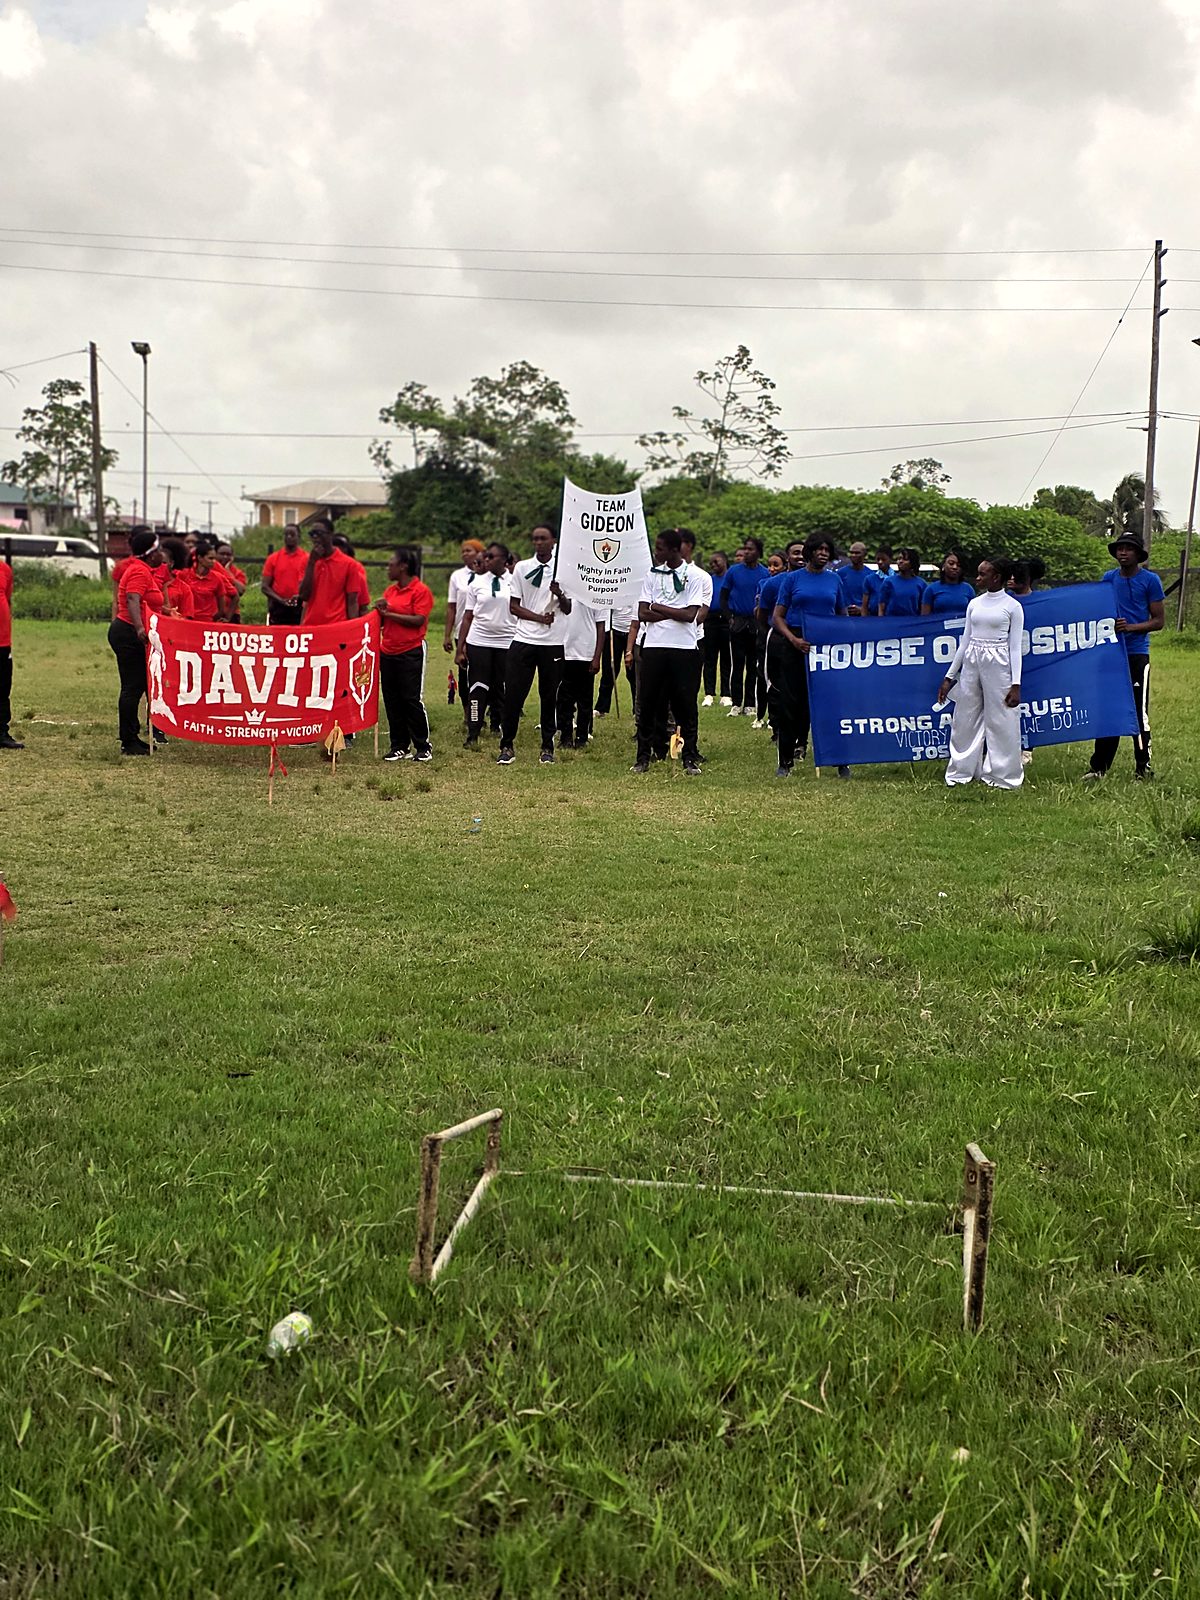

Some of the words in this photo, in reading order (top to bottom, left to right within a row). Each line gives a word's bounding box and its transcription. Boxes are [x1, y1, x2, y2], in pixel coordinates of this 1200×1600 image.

[596, 499, 626, 512] TEAM
[581, 512, 635, 533] GIDEON
[577, 563, 603, 576] Mighty
[613, 567, 631, 575] Faith
[580, 574, 618, 584] Victorious
[588, 585, 619, 594] Purpose
[203, 631, 274, 654] HOUSE
[285, 633, 314, 653] OF
[809, 636, 925, 672] HOUSE
[933, 635, 964, 664] O
[1022, 617, 1119, 656] SHUA
[175, 650, 338, 711] DAVID
[840, 715, 933, 735] STRONG
[1019, 696, 1072, 718] RUE!
[183, 720, 214, 736] FAITH
[224, 725, 279, 738] STRENGTH
[286, 723, 323, 737] VICTORY
[896, 728, 948, 748] VICTORY
[1023, 715, 1045, 734] WE
